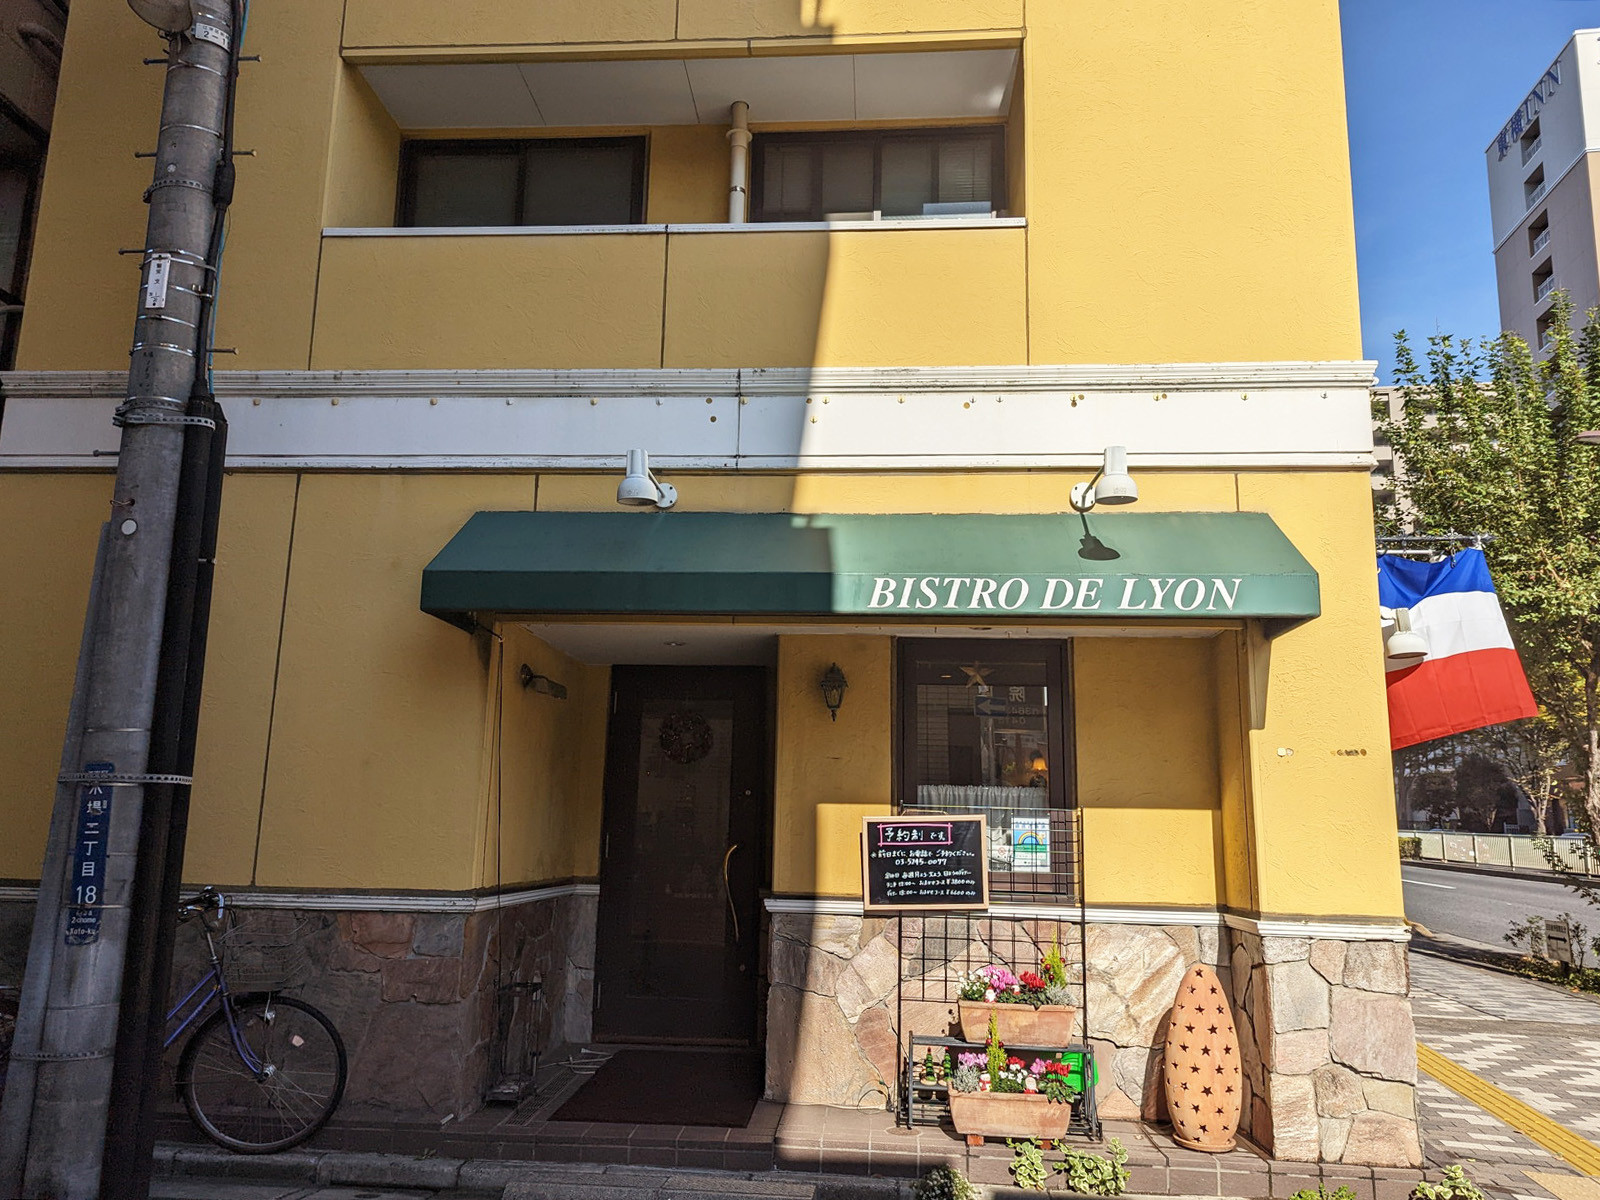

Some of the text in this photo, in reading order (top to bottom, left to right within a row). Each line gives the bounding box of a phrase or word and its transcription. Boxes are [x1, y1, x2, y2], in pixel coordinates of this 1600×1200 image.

[867, 577, 1243, 611] BISTRO DE LYON
[76, 885, 97, 904] 18
